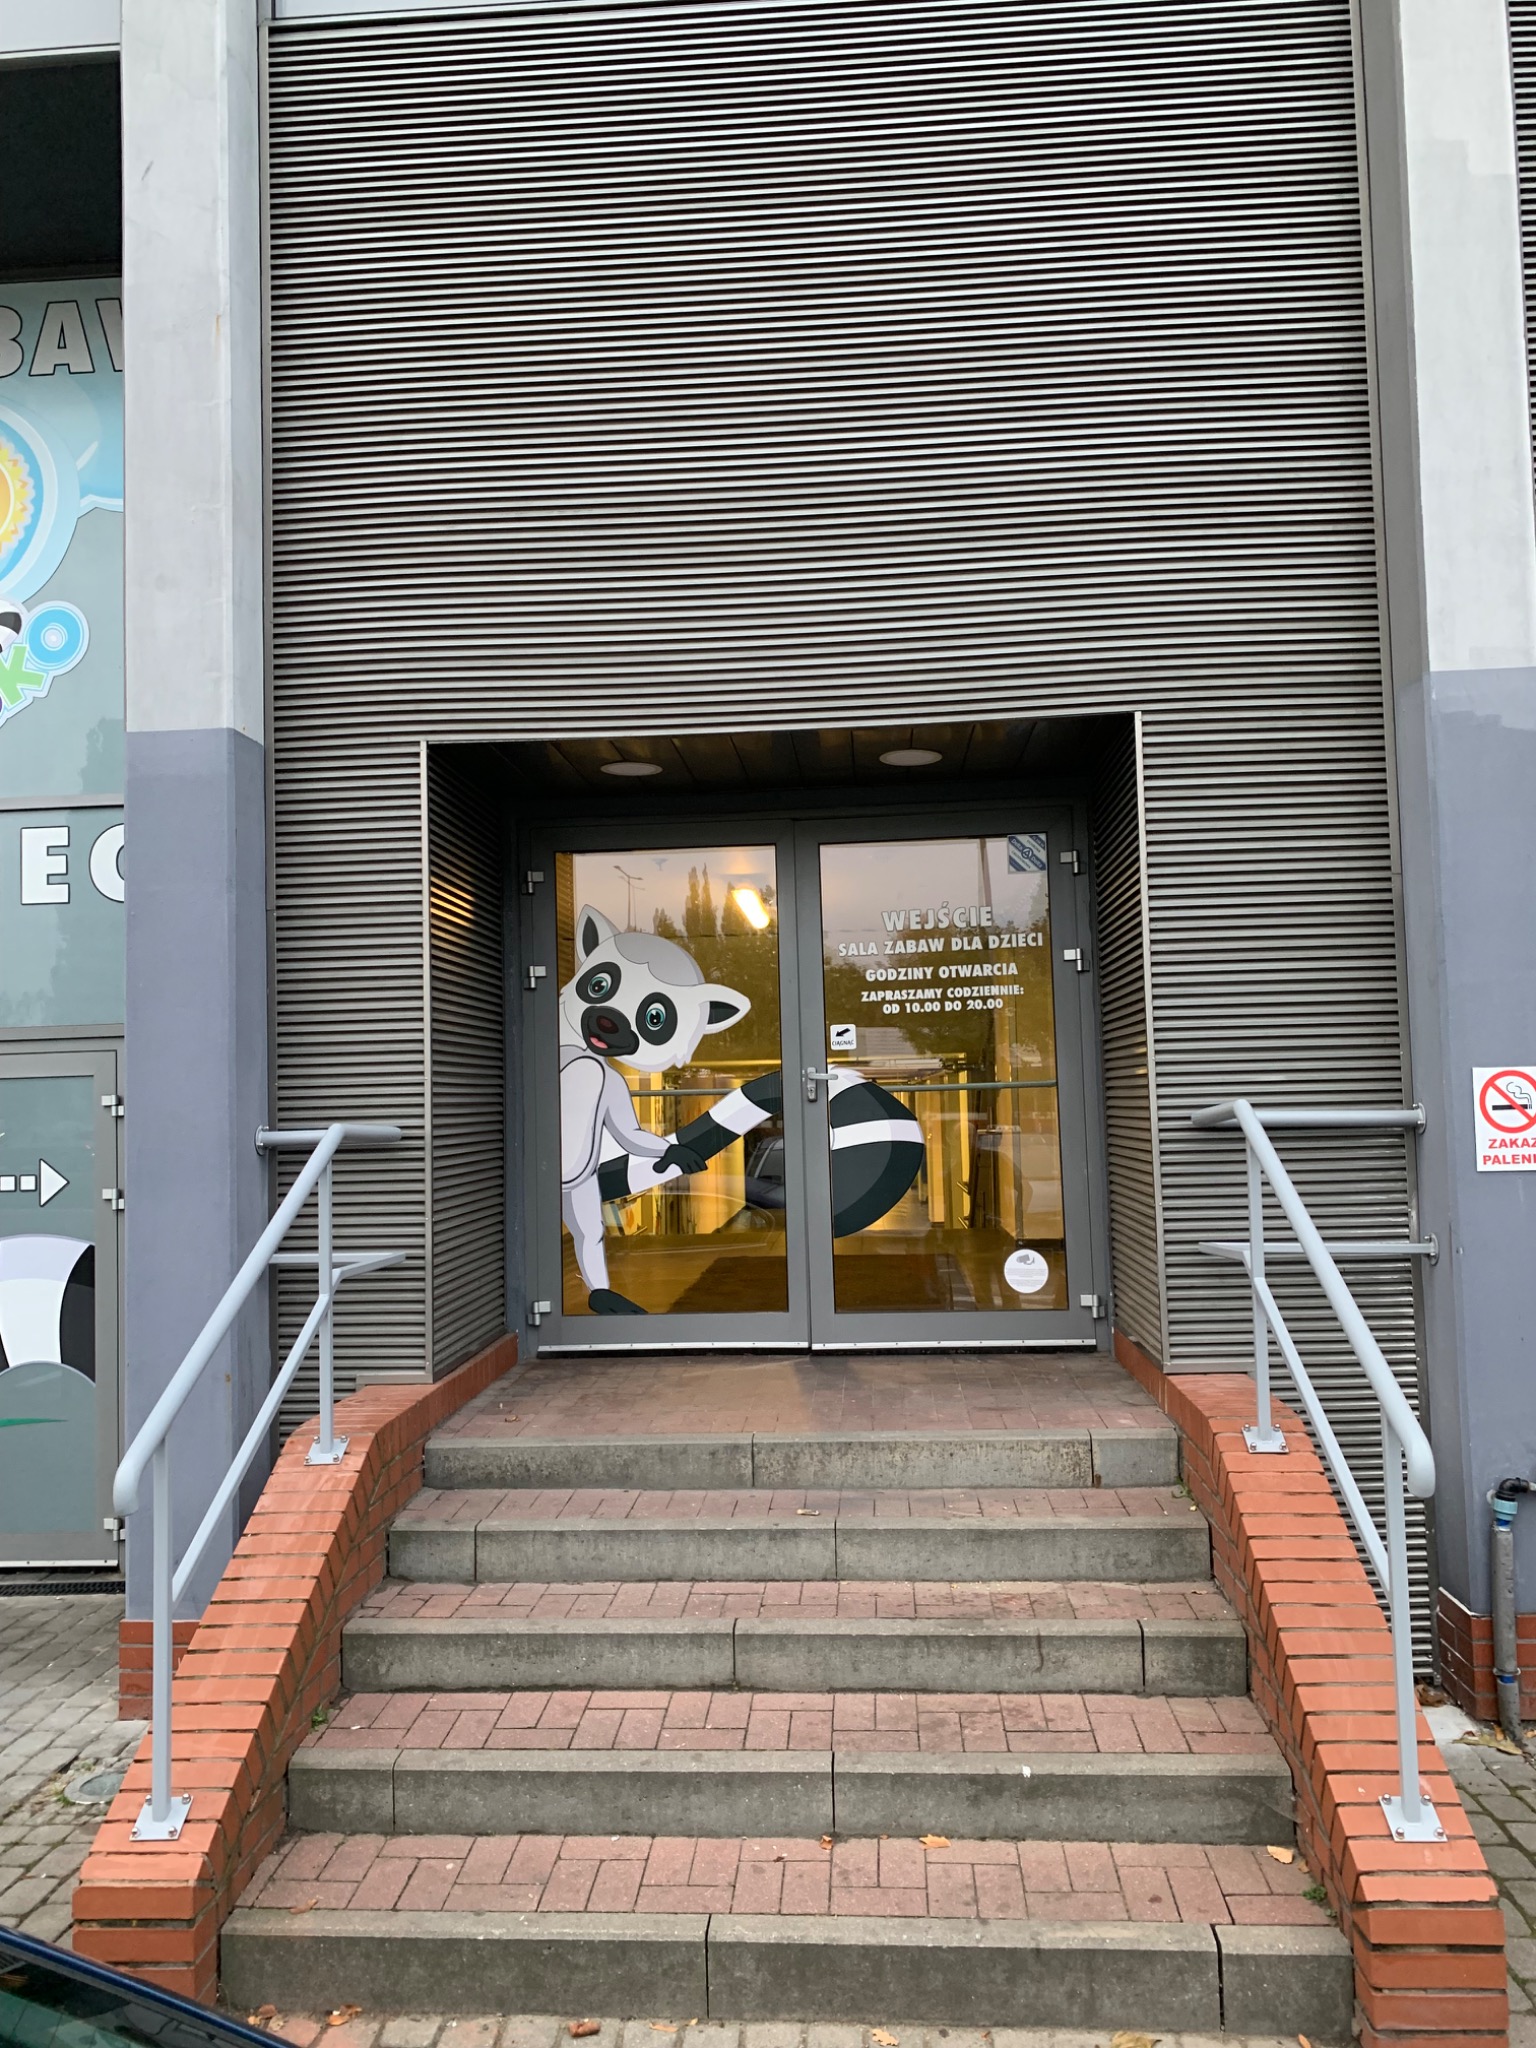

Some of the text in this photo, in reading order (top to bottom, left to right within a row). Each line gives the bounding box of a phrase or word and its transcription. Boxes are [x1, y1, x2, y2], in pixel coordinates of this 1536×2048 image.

[882, 901, 993, 932] WEJŚCIE
[838, 932, 1043, 957] SALA ZABAW DLA DZIECI
[865, 962, 1018, 982] GODZINY OTWARCIA
[861, 984, 1025, 1002] ZAPRASZAMY CODZIENNIE:
[883, 998, 1004, 1015] OD 10.00 DO 20.00
